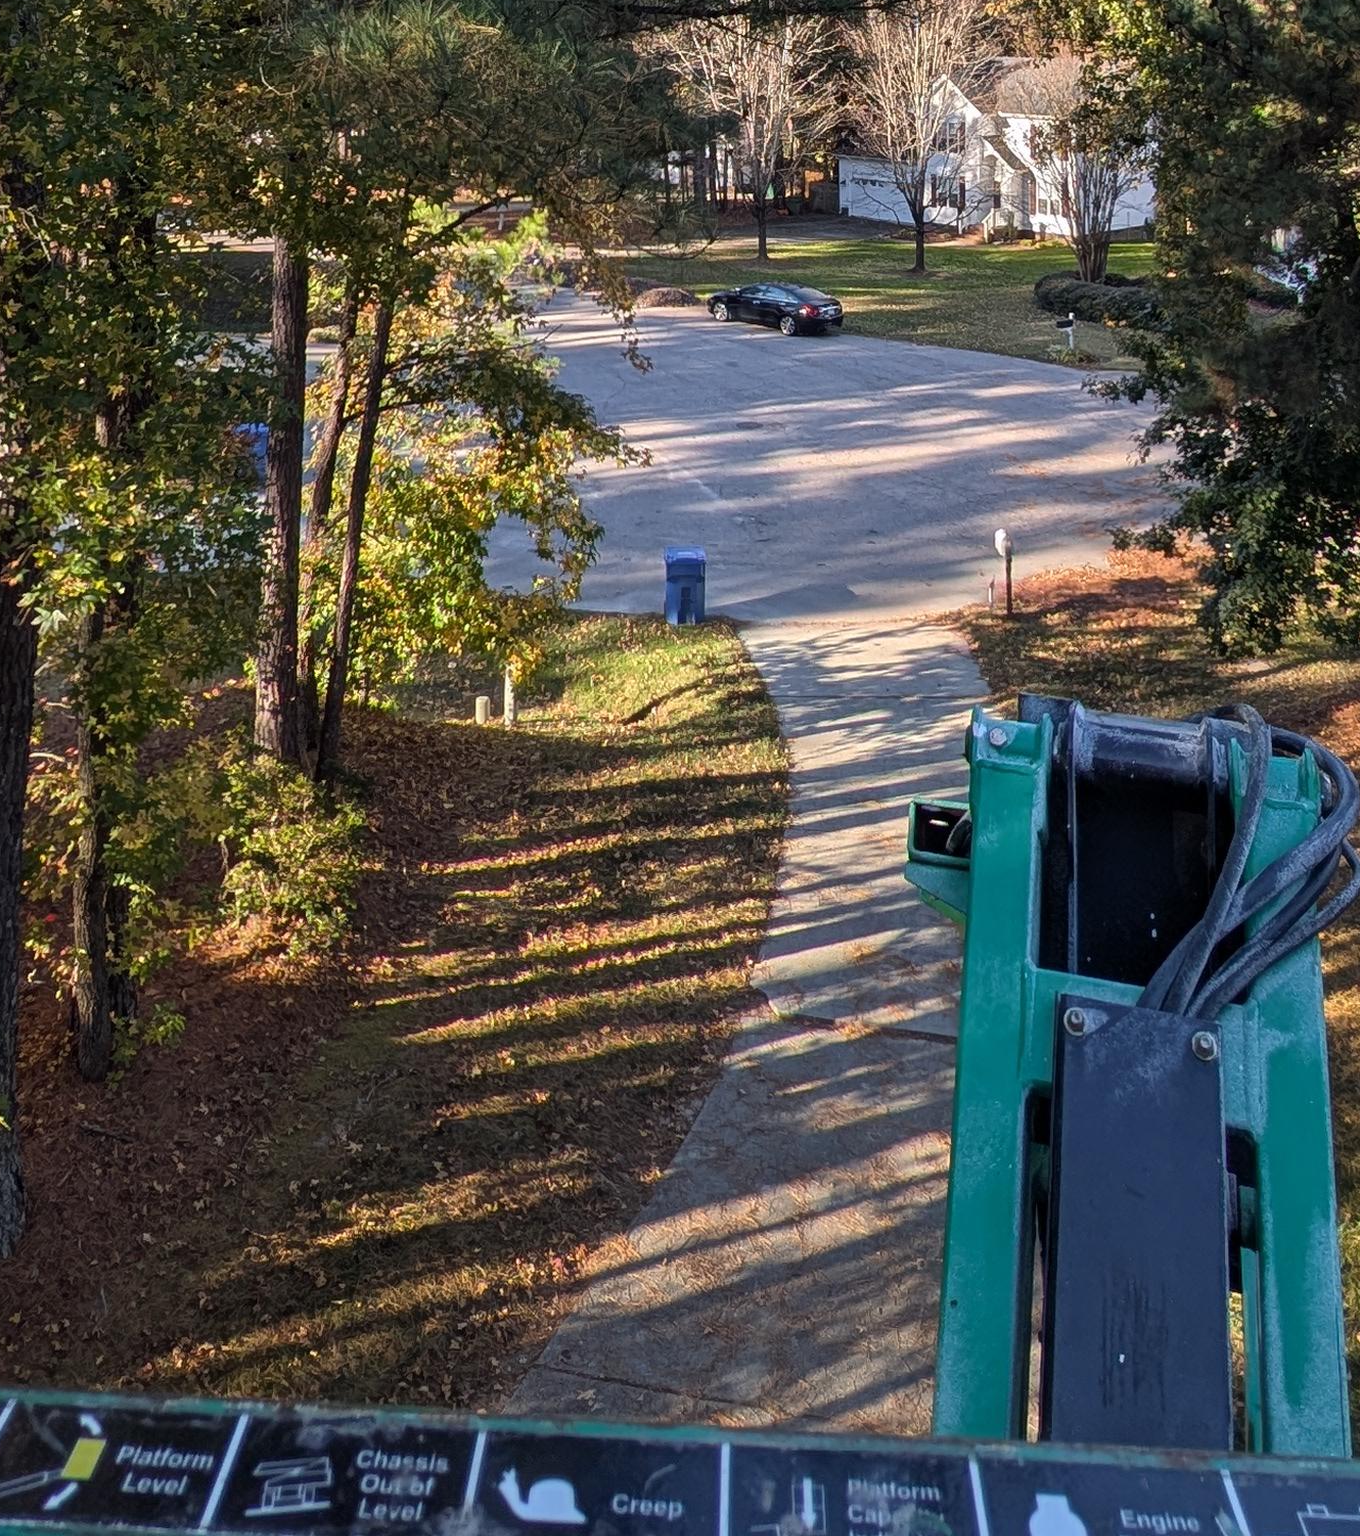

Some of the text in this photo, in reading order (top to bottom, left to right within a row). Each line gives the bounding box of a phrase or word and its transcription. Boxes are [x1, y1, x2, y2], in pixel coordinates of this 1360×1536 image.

[115, 1445, 215, 1471] Platform
[356, 1449, 450, 1474] Chassis
[121, 1472, 189, 1495] Level
[848, 1478, 941, 1502] Platform
[357, 1498, 424, 1522] Level
[612, 1493, 683, 1520] Creep
[1120, 1508, 1201, 1535] Engine
